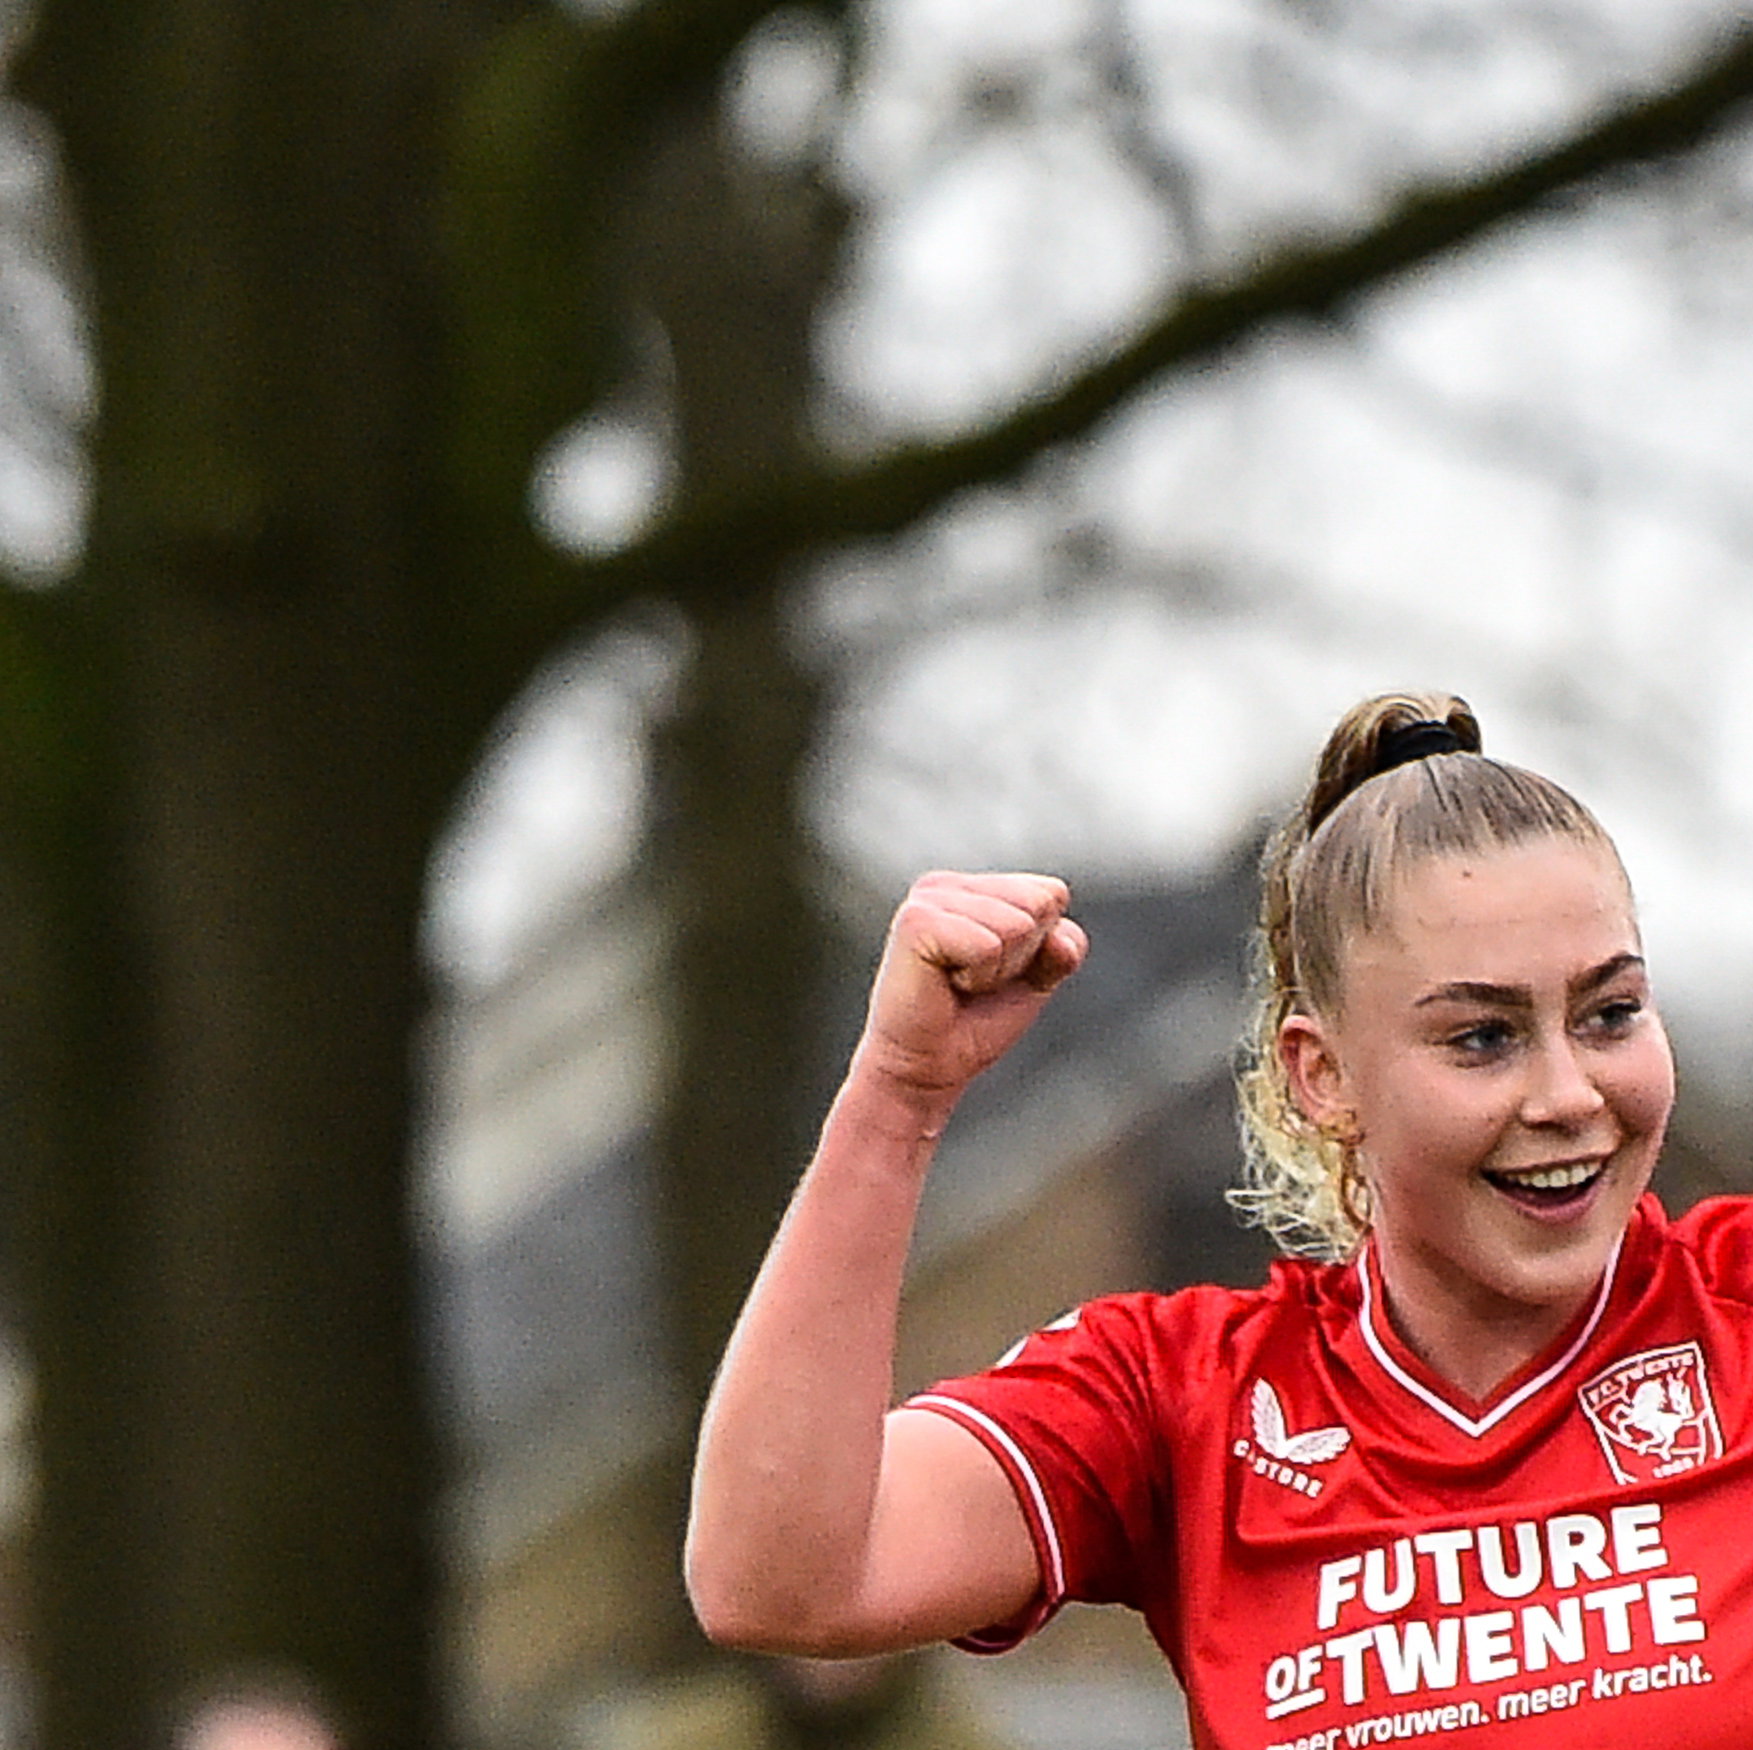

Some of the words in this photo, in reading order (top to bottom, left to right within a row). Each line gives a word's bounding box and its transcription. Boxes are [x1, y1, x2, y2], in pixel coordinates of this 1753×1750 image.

[1317, 1504, 1668, 1630] FUTURE
[1265, 1645, 1324, 1704] OF
[1326, 1575, 1706, 1705] TWENTE
[1345, 1701, 1490, 1750] vrouwen.
[1498, 1679, 1588, 1721] meer
[1592, 1654, 1713, 1700] kracht.
